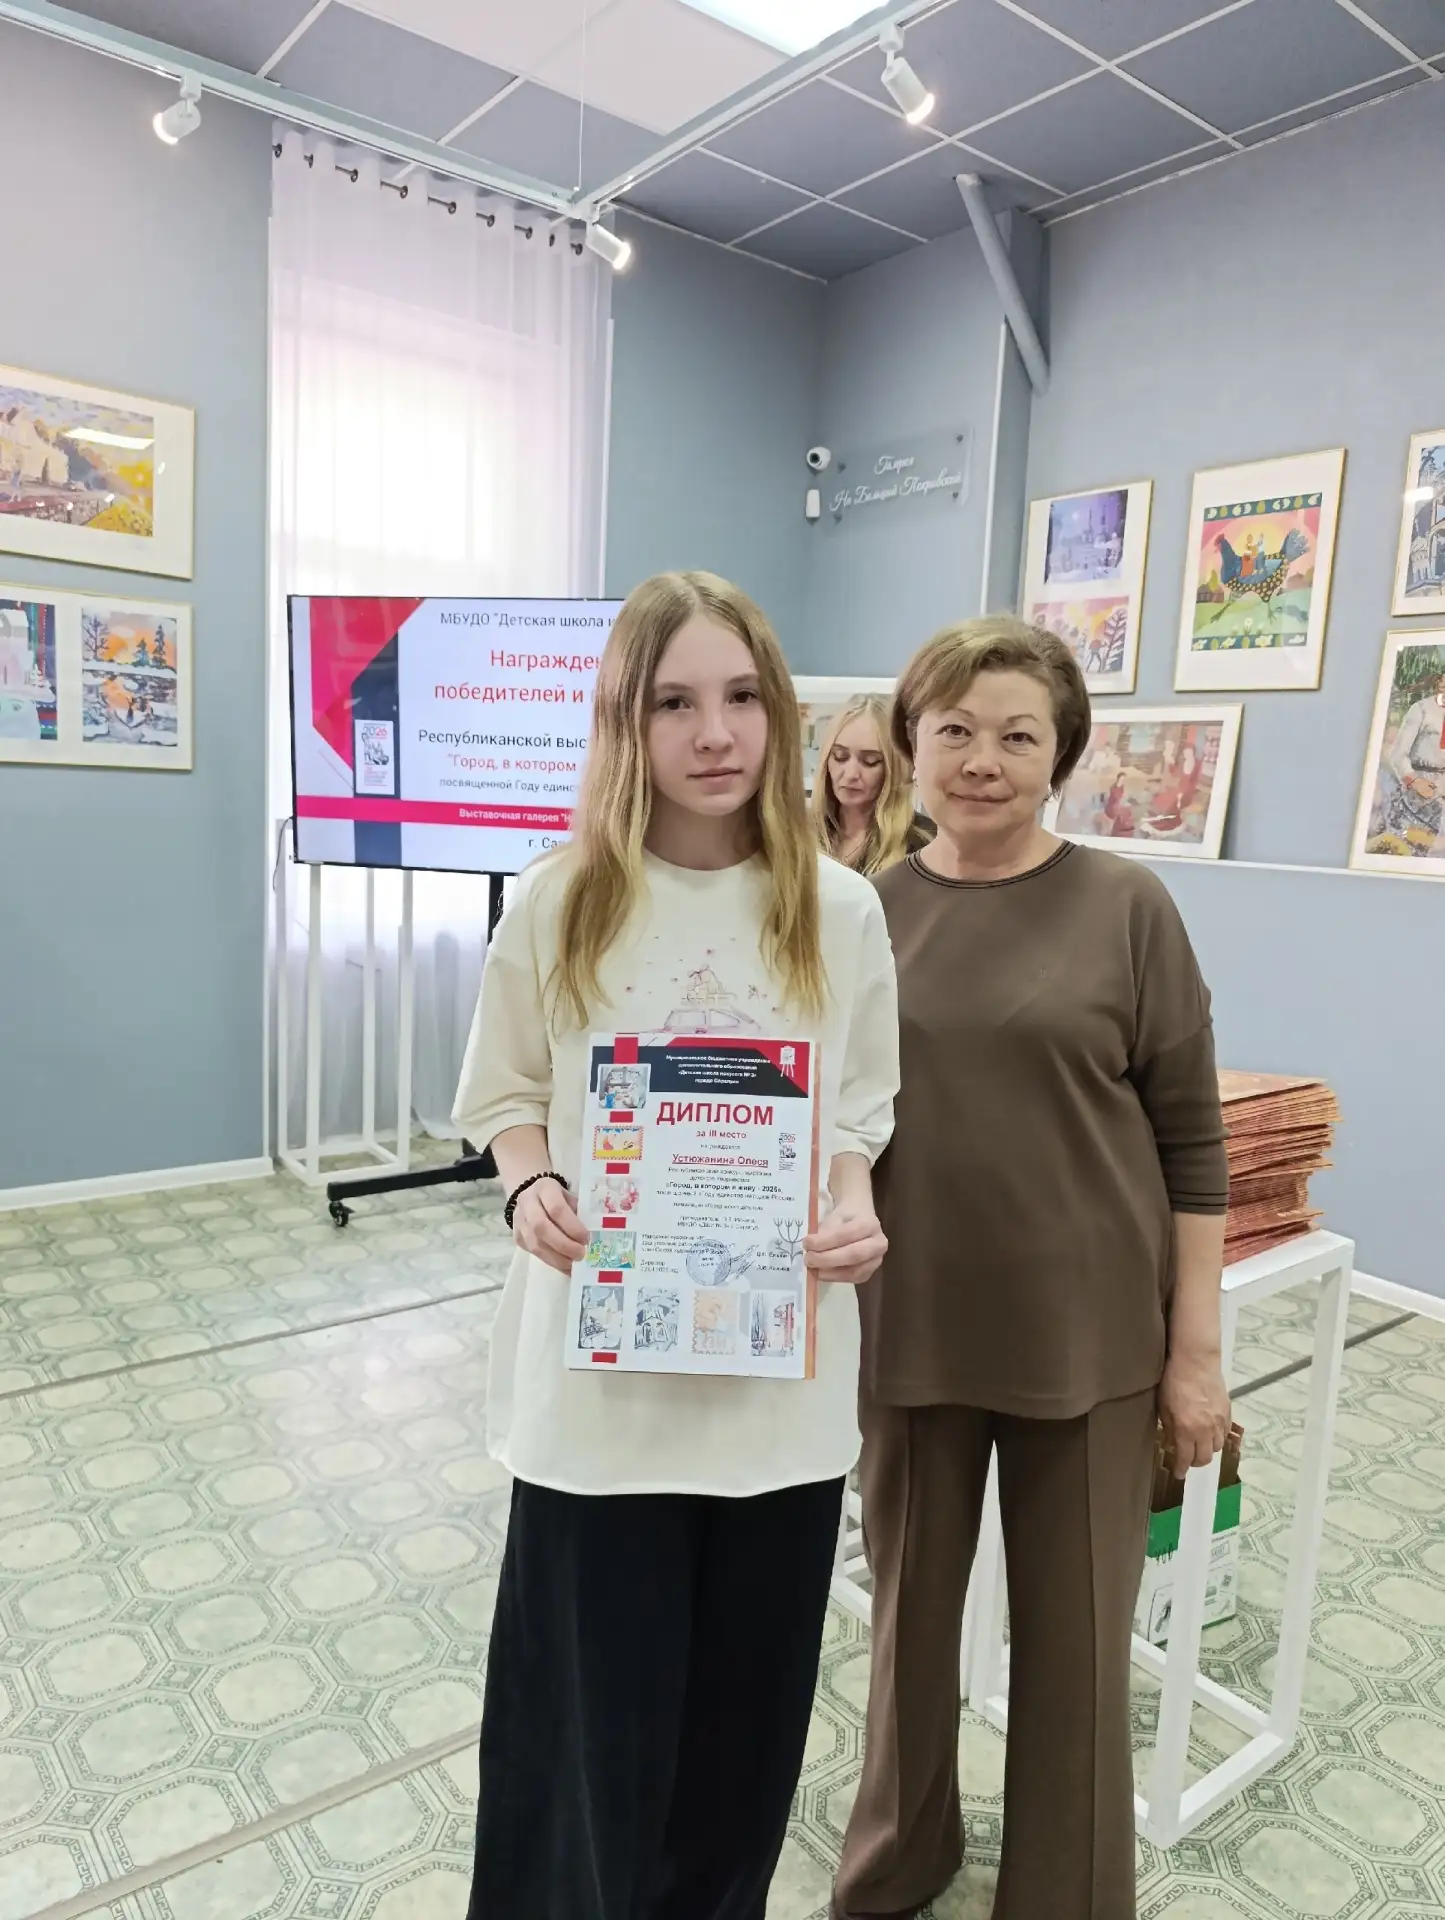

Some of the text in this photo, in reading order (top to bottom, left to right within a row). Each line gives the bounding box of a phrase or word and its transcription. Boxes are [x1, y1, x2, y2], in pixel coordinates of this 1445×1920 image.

[440, 612, 490, 628] МБУДО
[494, 613, 555, 627] "Детская
[560, 616, 604, 627] школа
[434, 682, 565, 703] победителей
[573, 689, 584, 703] и
[418, 729, 551, 748] Республиканской
[448, 754, 576, 774] "Город, в котором
[439, 778, 512, 790] посвященной
[515, 780, 539, 792] Году
[459, 808, 521, 821] Выставочная
[522, 812, 559, 823] галерея
[656, 1102, 773, 1126] ДИПЛОМ
[719, 1131, 746, 1139] место
[672, 1153, 734, 1164] Устюжанина
[737, 1156, 769, 1166] Олеся
